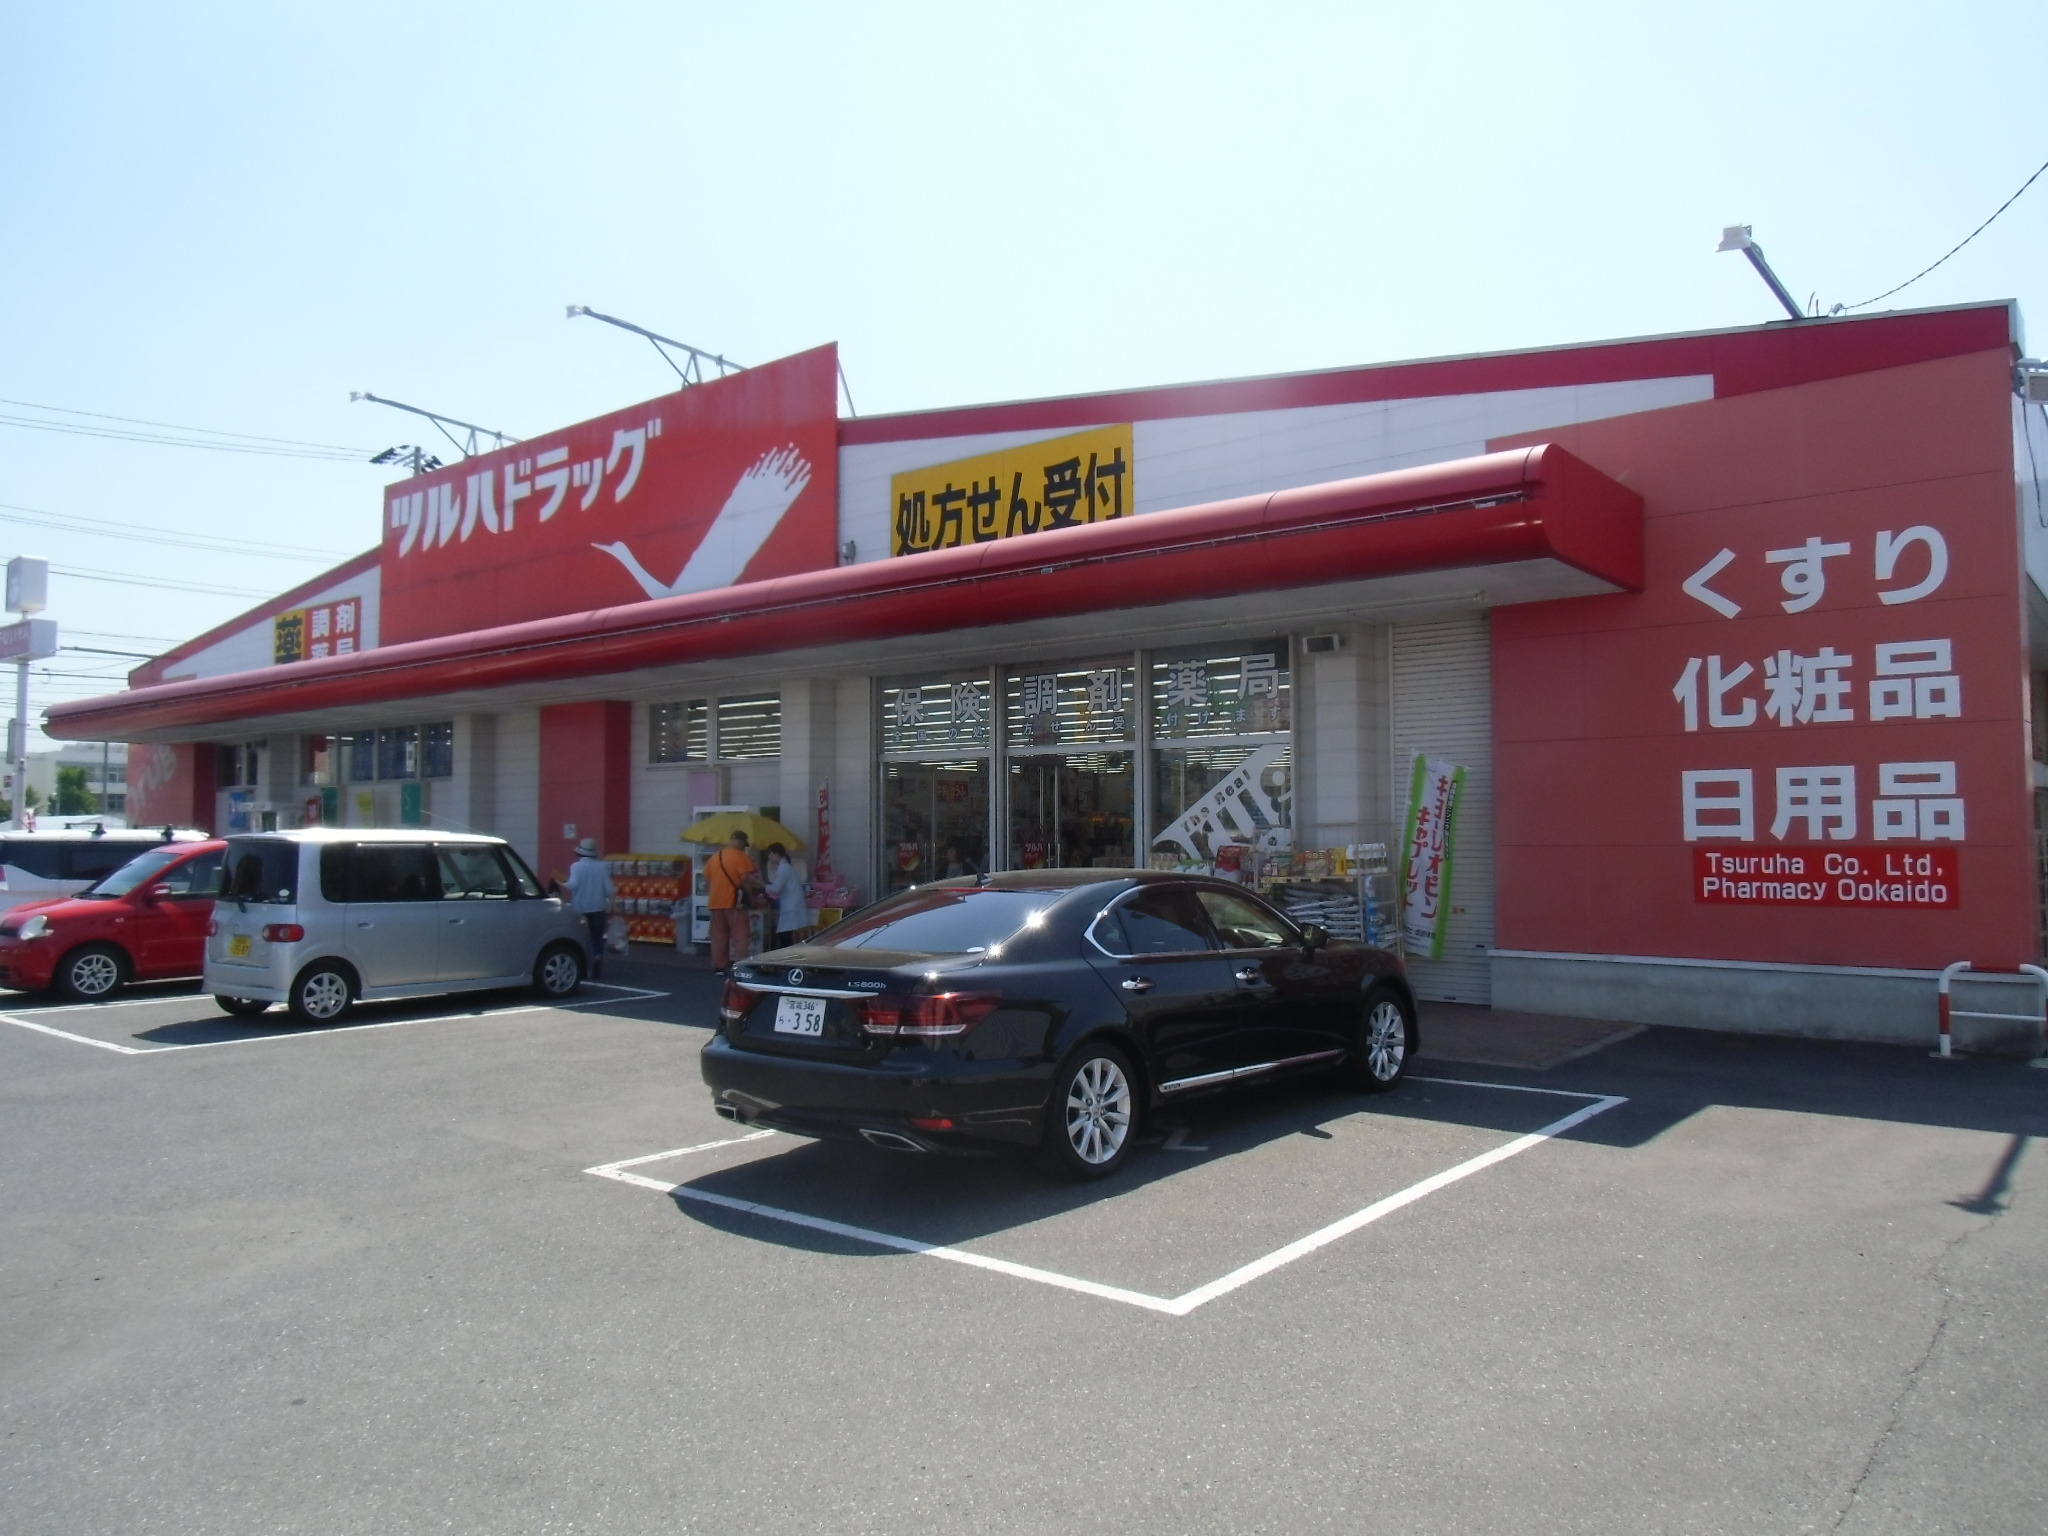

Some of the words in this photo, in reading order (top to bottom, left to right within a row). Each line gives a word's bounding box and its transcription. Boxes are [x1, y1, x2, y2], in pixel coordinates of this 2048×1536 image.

[392, 418, 661, 558] ツルハドラッグ
[896, 447, 1126, 556] 処方せん受付
[1682, 525, 1948, 619] くすり
[1672, 638, 1961, 732] 化粧品
[1682, 761, 1965, 842] 日用品
[1703, 877, 1827, 901] Pharmacy
[1838, 878, 1947, 904] Ookaido
[1706, 852, 1804, 875] Tsuruha
[1824, 853, 1868, 876] Co.
